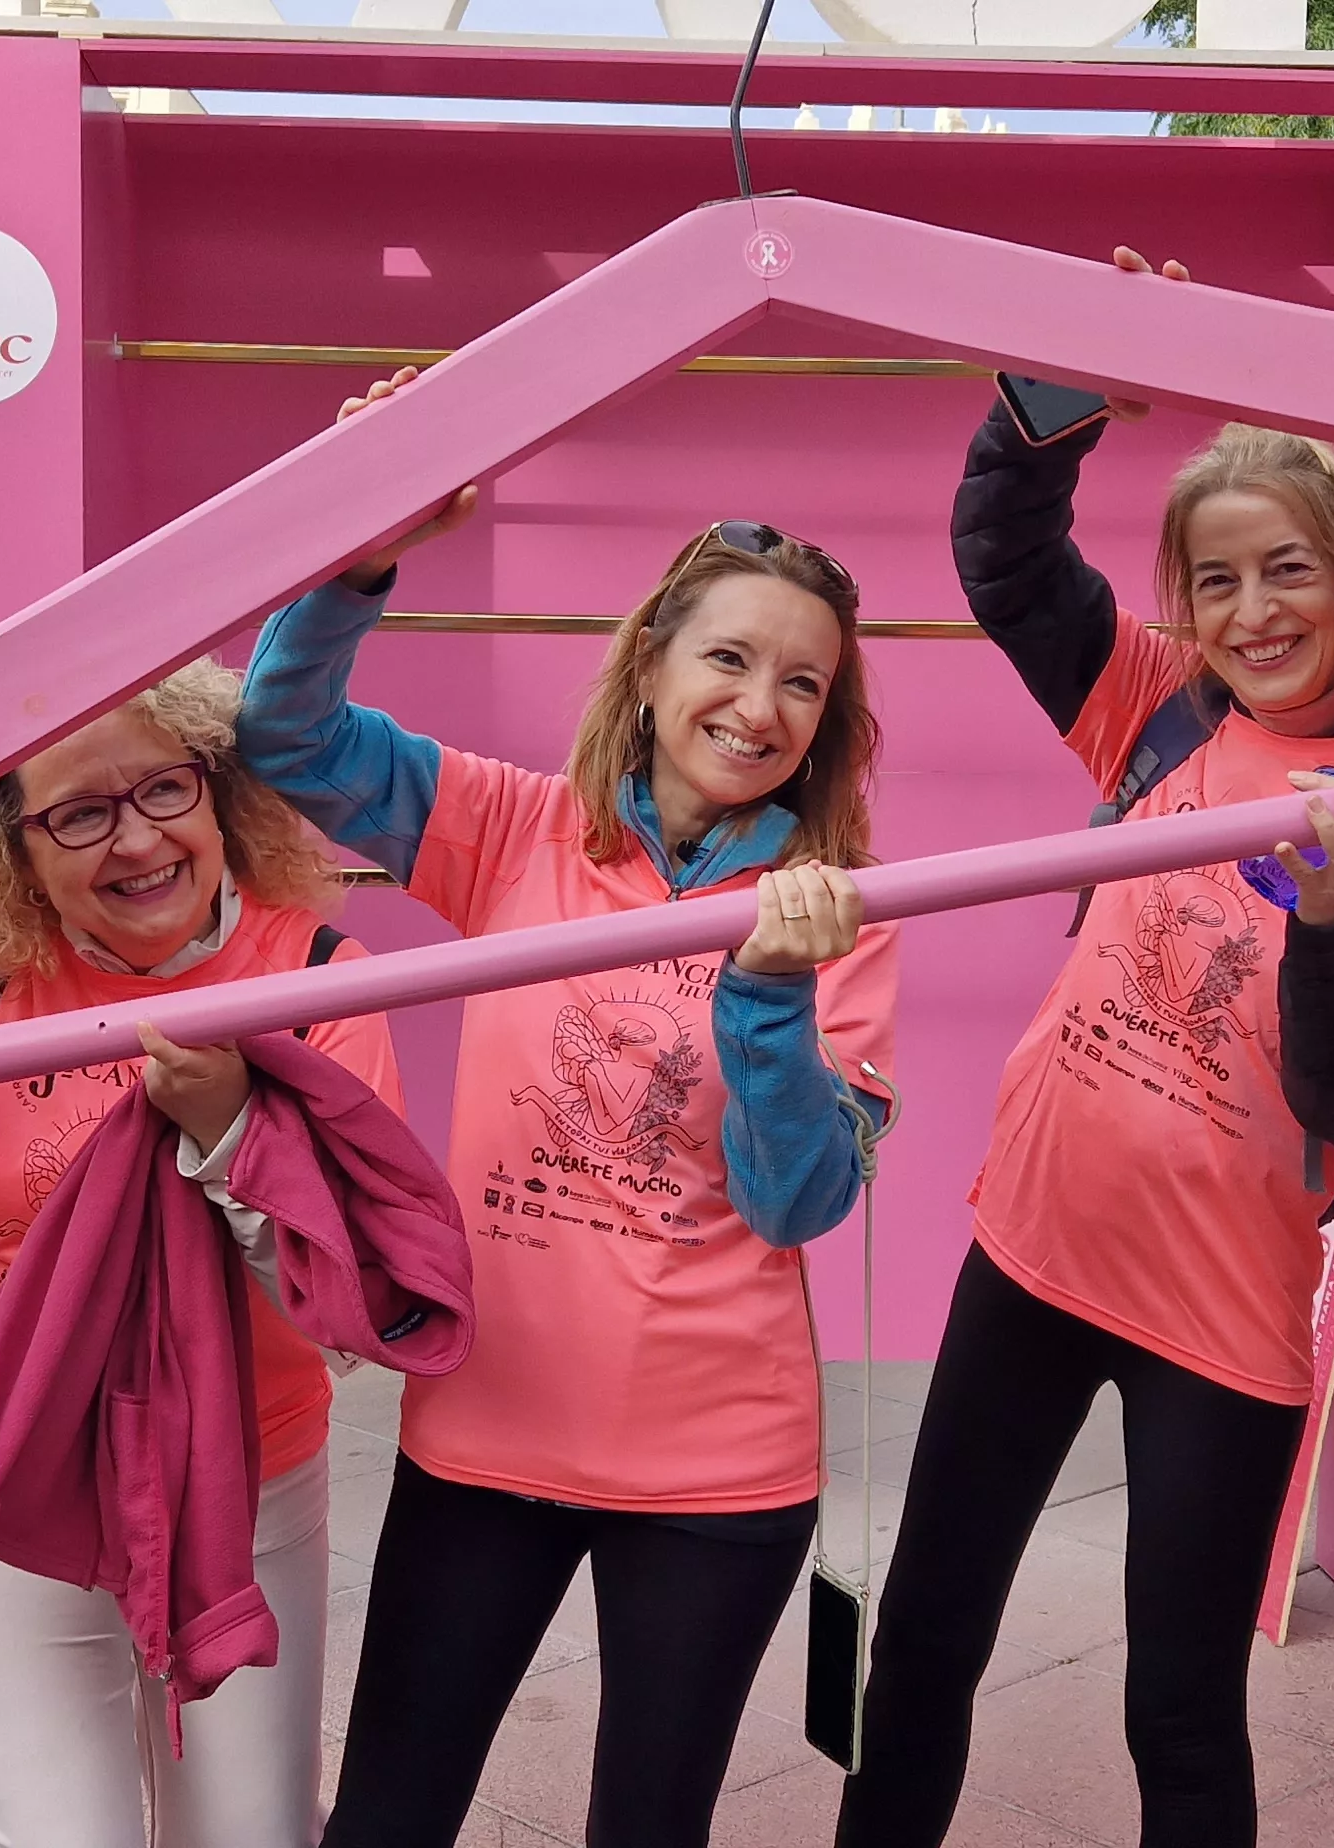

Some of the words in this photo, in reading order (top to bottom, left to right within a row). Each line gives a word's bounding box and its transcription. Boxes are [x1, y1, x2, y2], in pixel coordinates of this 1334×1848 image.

[1100, 998, 1180, 1048] QUIÉRETE
[531, 1147, 613, 1181] QUIÉRETE
[618, 1174, 682, 1197] MUCHO
[548, 1210, 585, 1225] Alcampo
